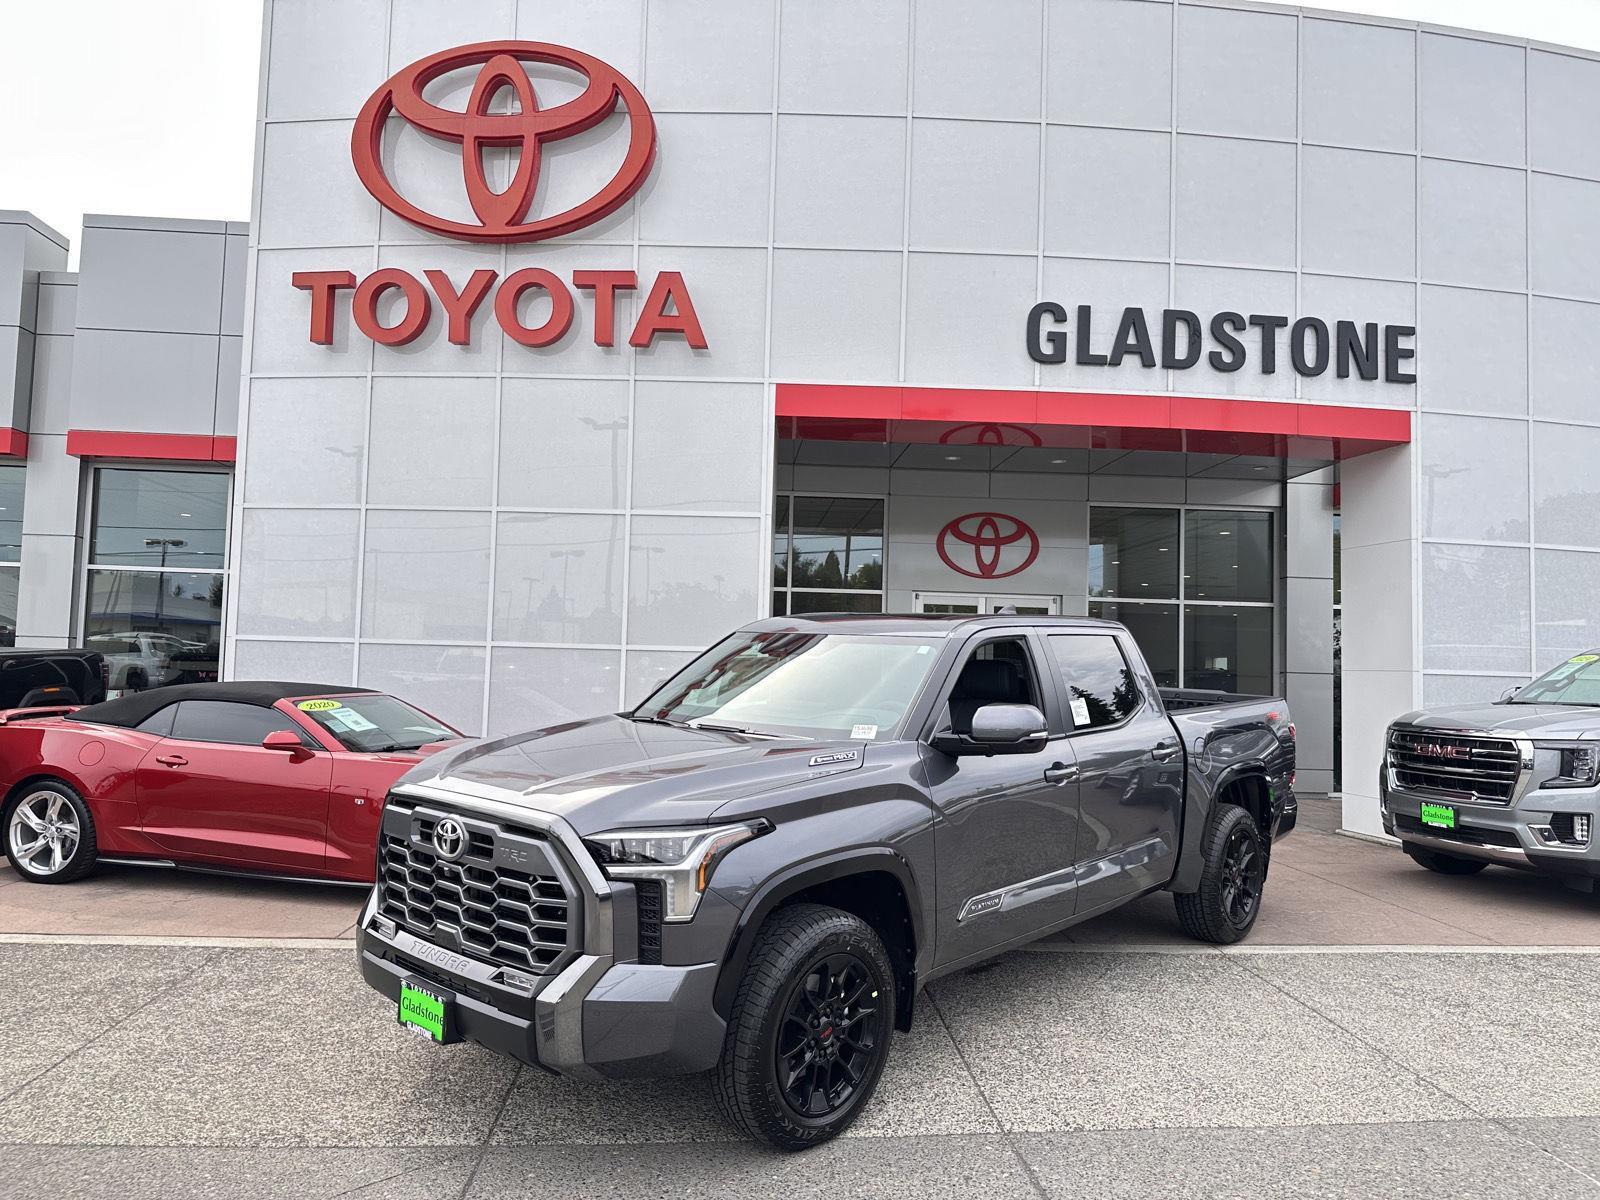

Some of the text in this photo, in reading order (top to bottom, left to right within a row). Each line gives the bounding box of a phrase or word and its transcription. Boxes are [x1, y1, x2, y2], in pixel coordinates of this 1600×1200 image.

[292, 267, 708, 349] TOYOTA
[1026, 301, 1417, 384] GLADSTONE
[306, 701, 335, 710] 2020
[1414, 743, 1470, 760] GMC
[1423, 809, 1454, 822] Gladstone
[410, 940, 470, 973] TUNDRA
[402, 996, 444, 1026] Gladstone
